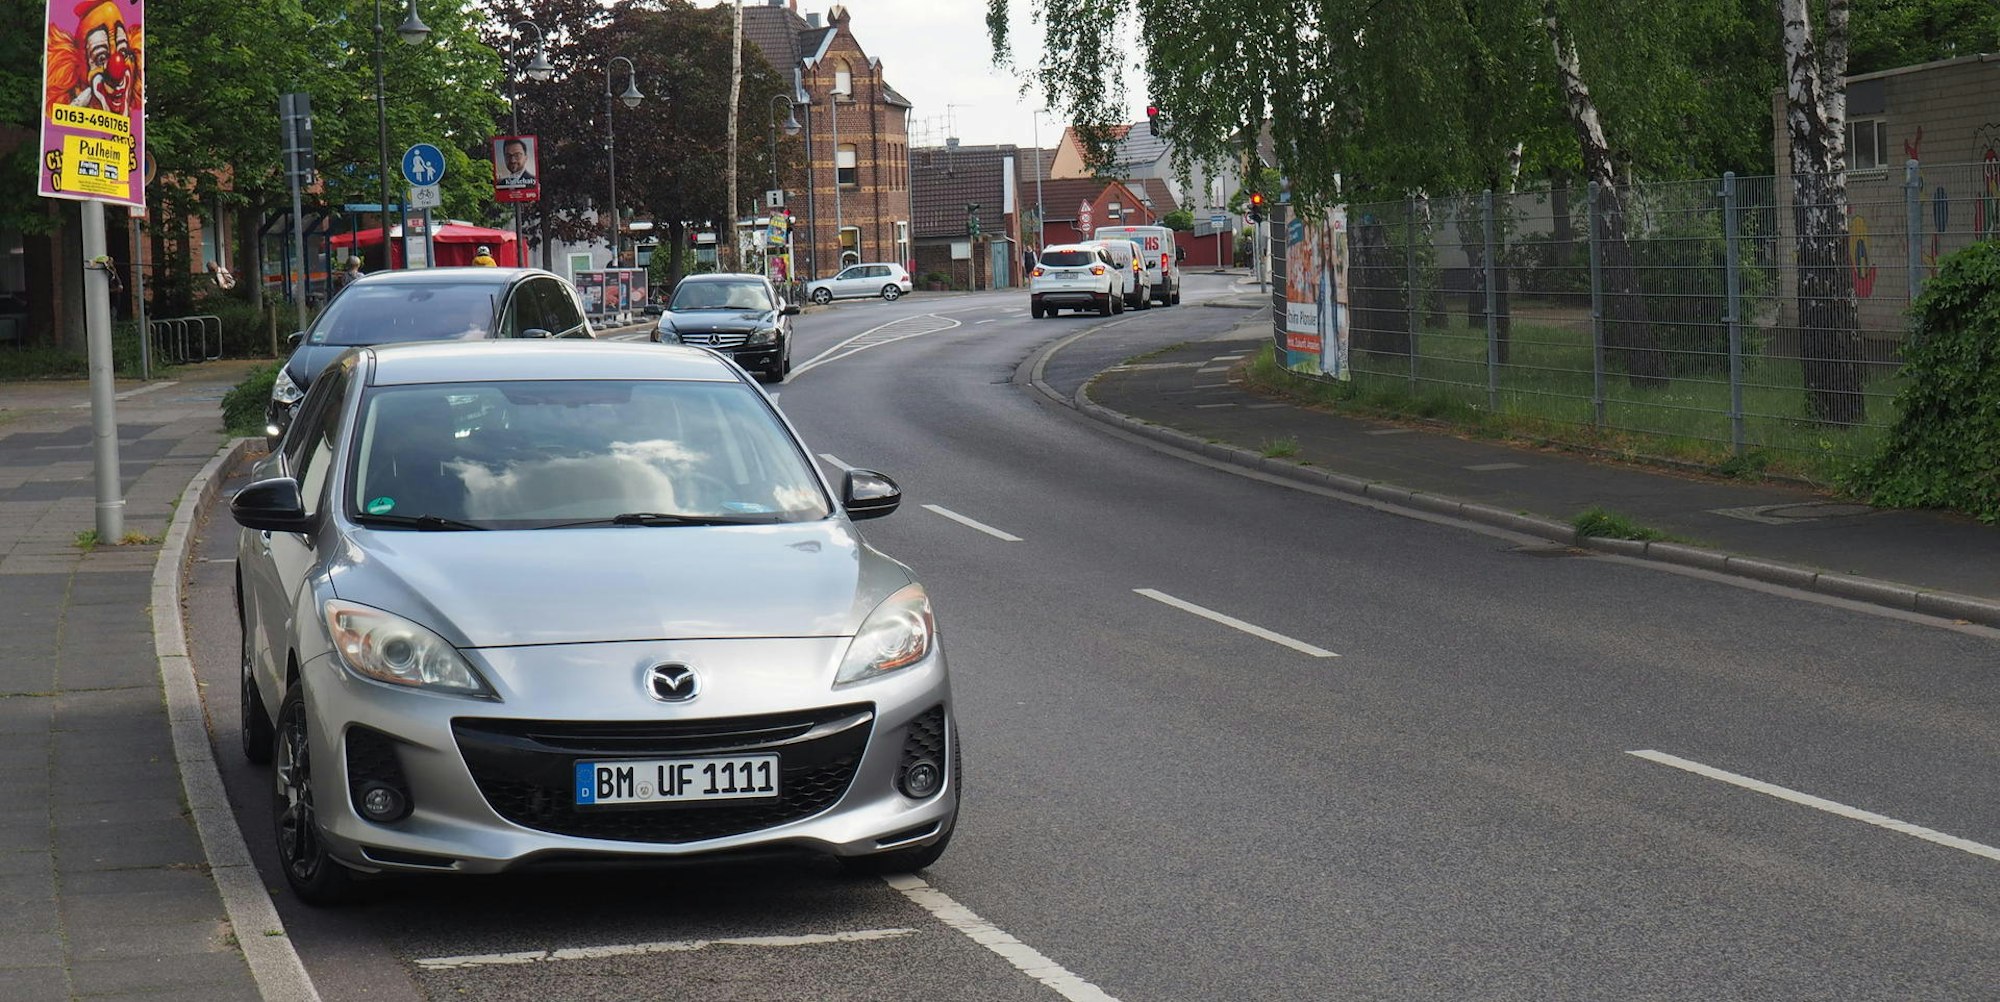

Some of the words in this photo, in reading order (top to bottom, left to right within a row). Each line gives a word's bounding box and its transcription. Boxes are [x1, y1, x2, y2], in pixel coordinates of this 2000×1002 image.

[55, 109, 128, 132] 0163-4961765
[79, 140, 121, 160] Pulheim
[1145, 236, 1159, 251] HS
[597, 766, 634, 799] BM
[658, 764, 694, 797] UF
[703, 761, 774, 794] 1111
[581, 787, 589, 798] D
